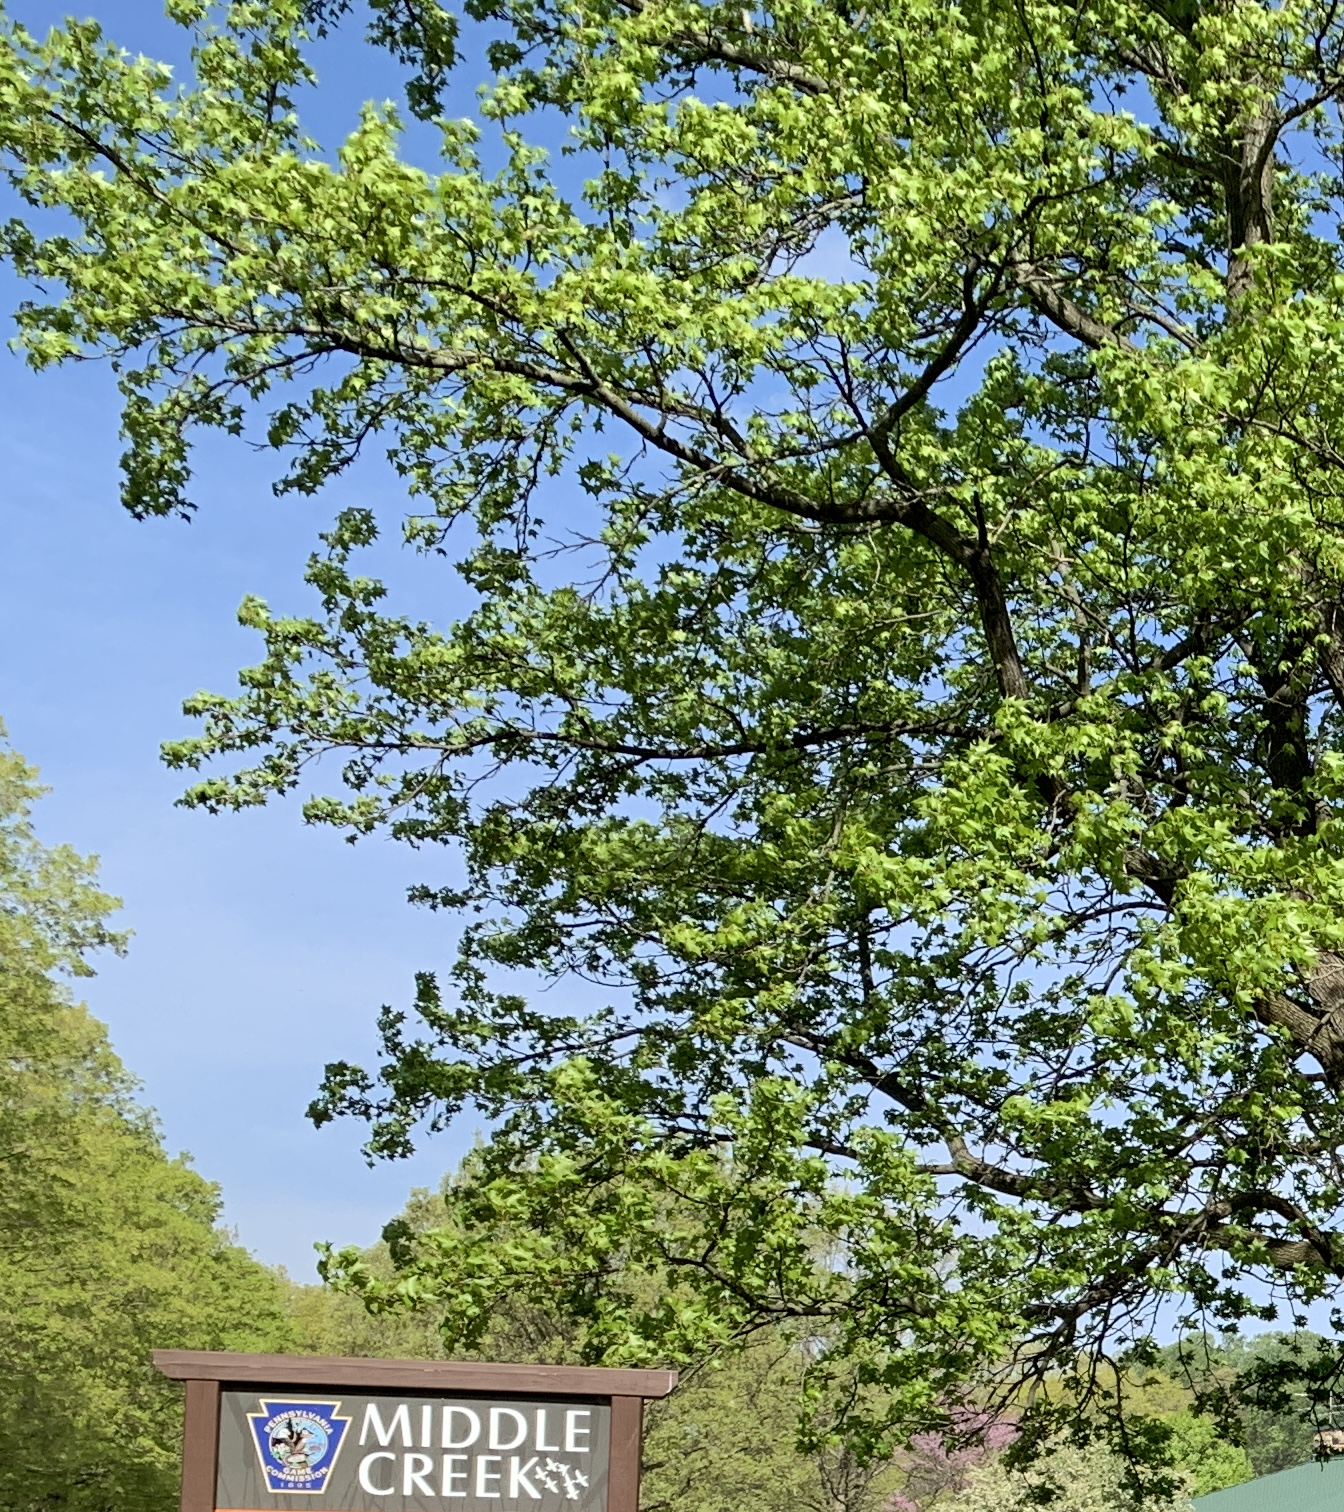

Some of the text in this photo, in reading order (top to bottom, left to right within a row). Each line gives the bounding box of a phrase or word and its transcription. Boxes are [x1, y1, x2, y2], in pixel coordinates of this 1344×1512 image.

[263, 1410, 334, 1435] PENNSYLVANIA
[358, 1403, 591, 1453] MIDDLE
[266, 1466, 329, 1482] COMMISSION
[282, 1467, 313, 1476] GAME
[357, 1452, 542, 1499] CREEK
